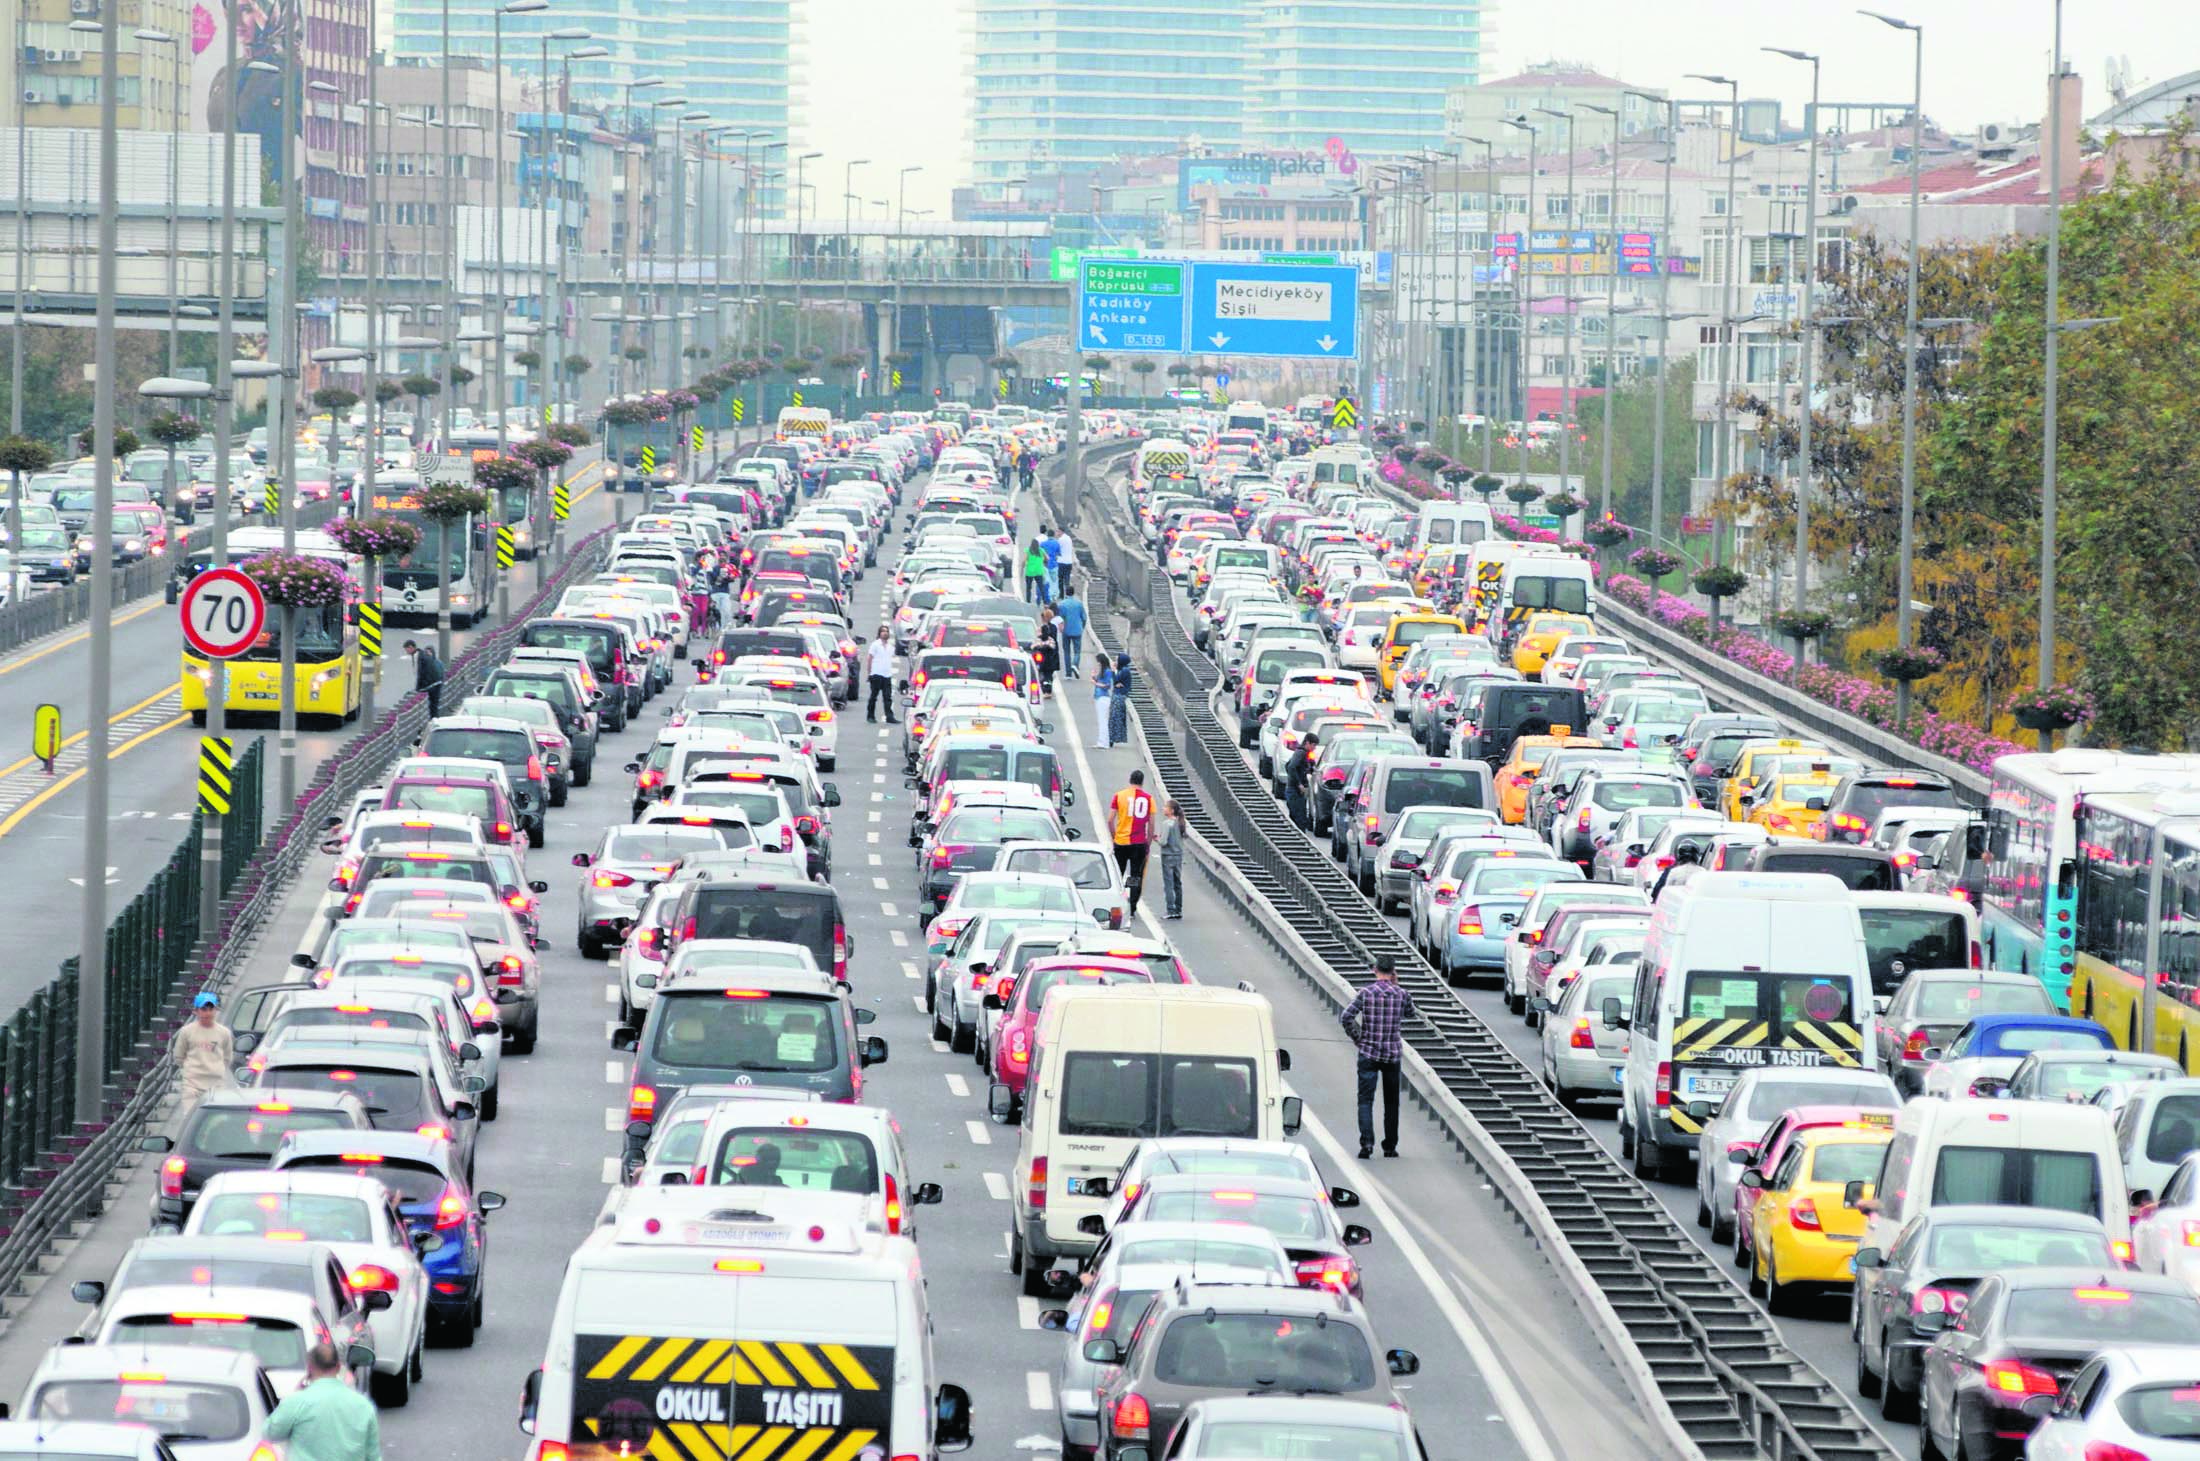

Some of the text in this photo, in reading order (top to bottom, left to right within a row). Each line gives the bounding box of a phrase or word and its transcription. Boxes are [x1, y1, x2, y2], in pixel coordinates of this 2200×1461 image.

[1221, 284, 1324, 301] Mecidiyeköy
[1088, 296, 1152, 312] Kadıköy
[1221, 302, 1257, 316] Şişli
[1088, 312, 1147, 324] Ankara
[203, 594, 246, 634] 70
[1127, 796, 1149, 818] 10
[1724, 1048, 1766, 1064] OKUL
[1770, 1050, 1820, 1067] TAŞITI
[655, 1386, 842, 1430] OKUL TAŞITI
